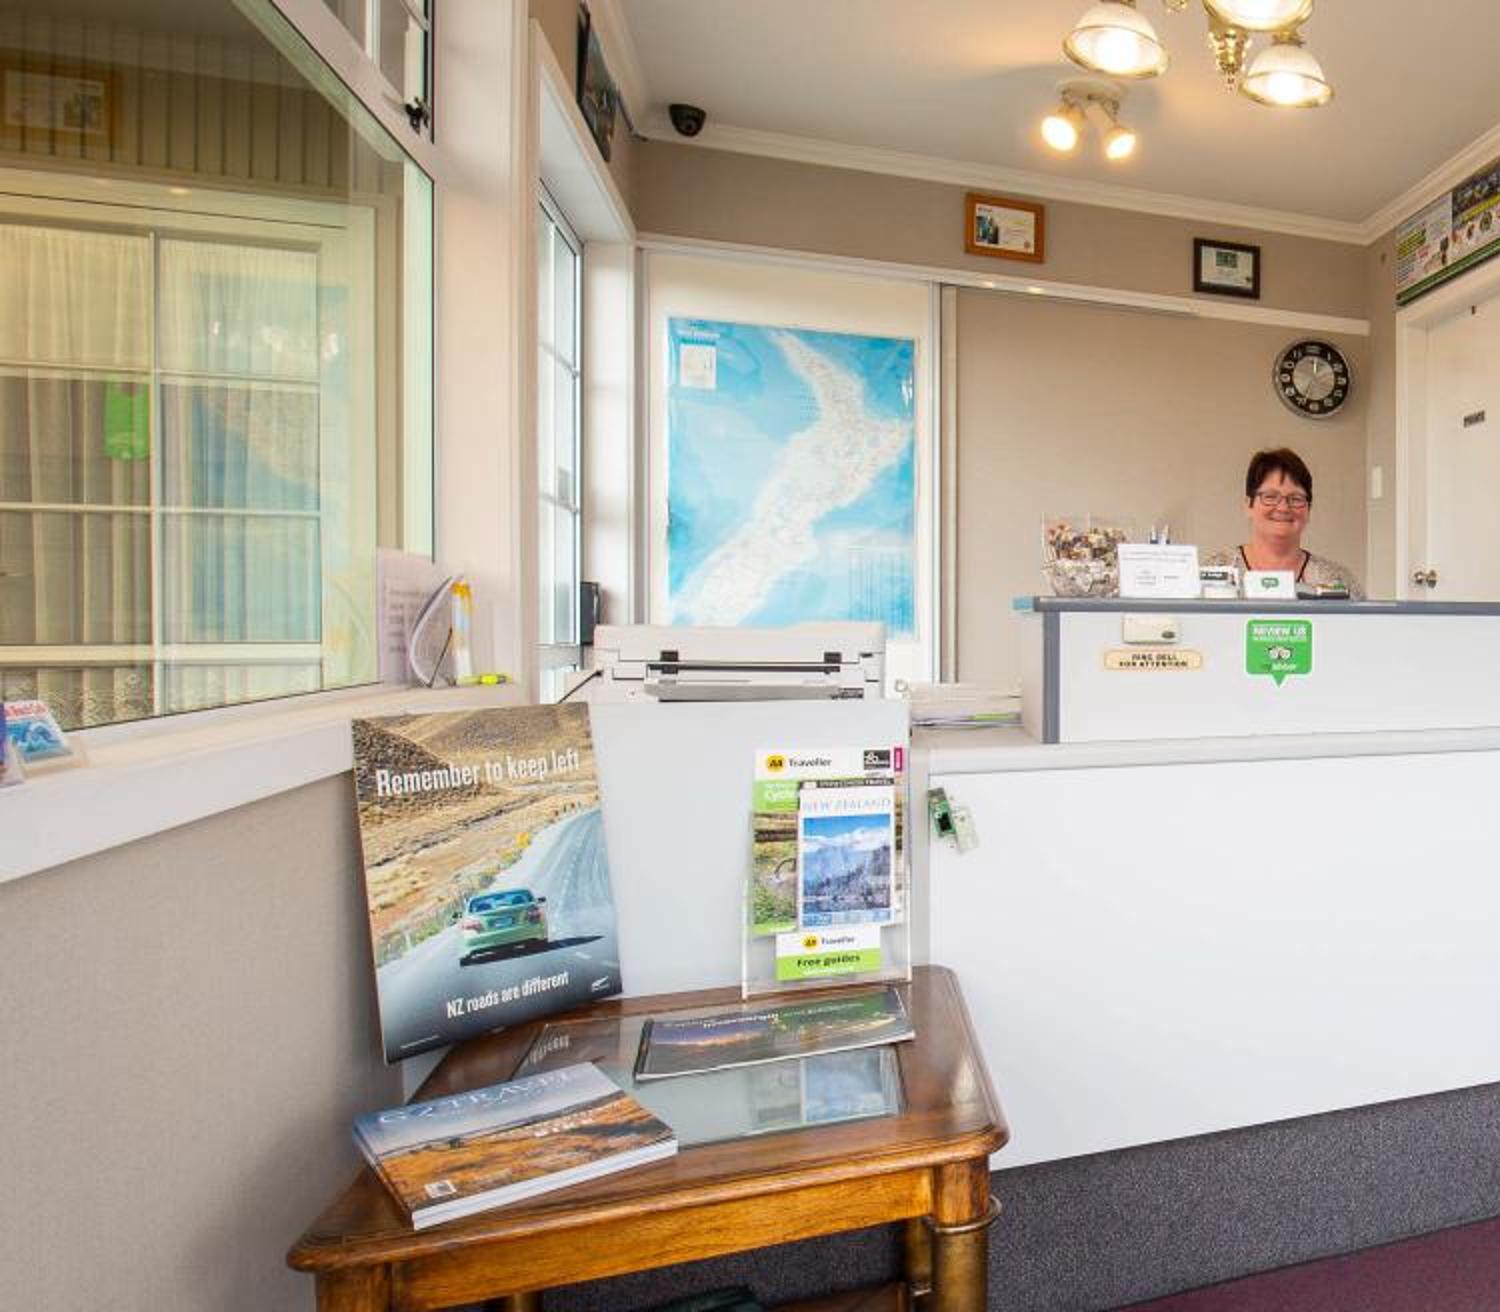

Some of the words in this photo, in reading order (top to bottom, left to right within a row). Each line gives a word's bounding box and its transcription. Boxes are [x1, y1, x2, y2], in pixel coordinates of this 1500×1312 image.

[788, 757, 832, 768] Traveller
[376, 764, 479, 797] Remember
[485, 759, 503, 781] to
[507, 754, 549, 781] keep
[551, 747, 581, 771] left
[822, 936, 855, 945] Traveller
[797, 957, 821, 968] Free
[823, 954, 861, 968] guides
[446, 998, 465, 1019] NZ
[467, 990, 500, 1013] roads
[501, 987, 521, 1004] are
[522, 971, 570, 998] different
